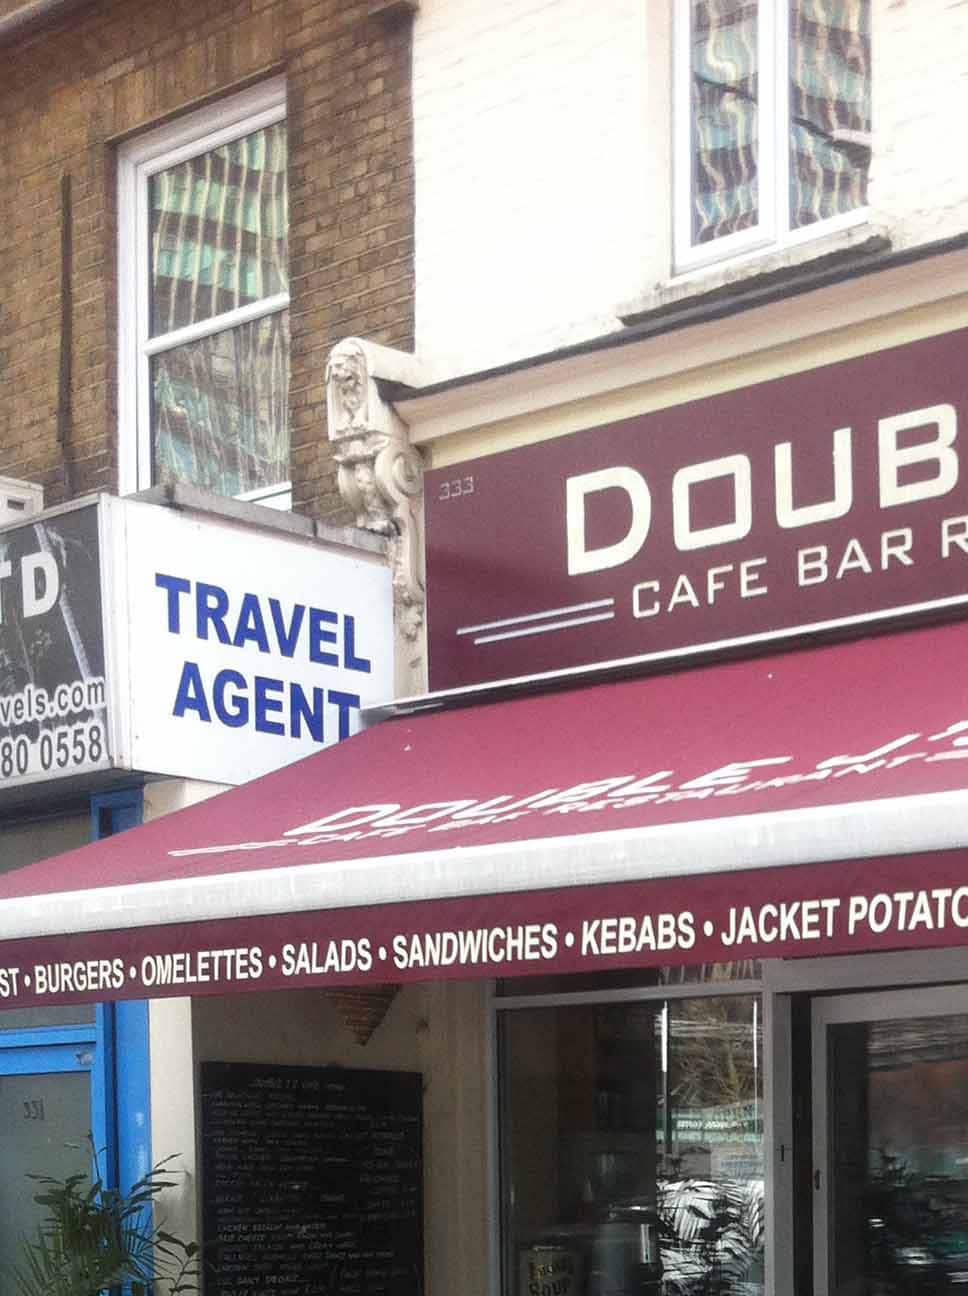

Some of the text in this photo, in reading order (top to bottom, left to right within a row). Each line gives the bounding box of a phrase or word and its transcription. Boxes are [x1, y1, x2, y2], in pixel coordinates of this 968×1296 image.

[438, 475, 476, 501] 333
[0, 551, 60, 618] D
[632, 556, 769, 619] CAFE
[797, 526, 914, 588] BAR
[155, 572, 371, 674] TRAVEL
[172, 660, 361, 744] AGENT
[40, 724, 102, 772] 0558
[284, 755, 792, 837] DOUBLE
[35, 958, 124, 994] BURGERS
[141, 946, 264, 987] OMELETTES
[281, 938, 372, 976] SALADS
[392, 923, 558, 969] SANDWICHES
[581, 911, 695, 956] KEBABS
[721, 898, 841, 946] JACKET
